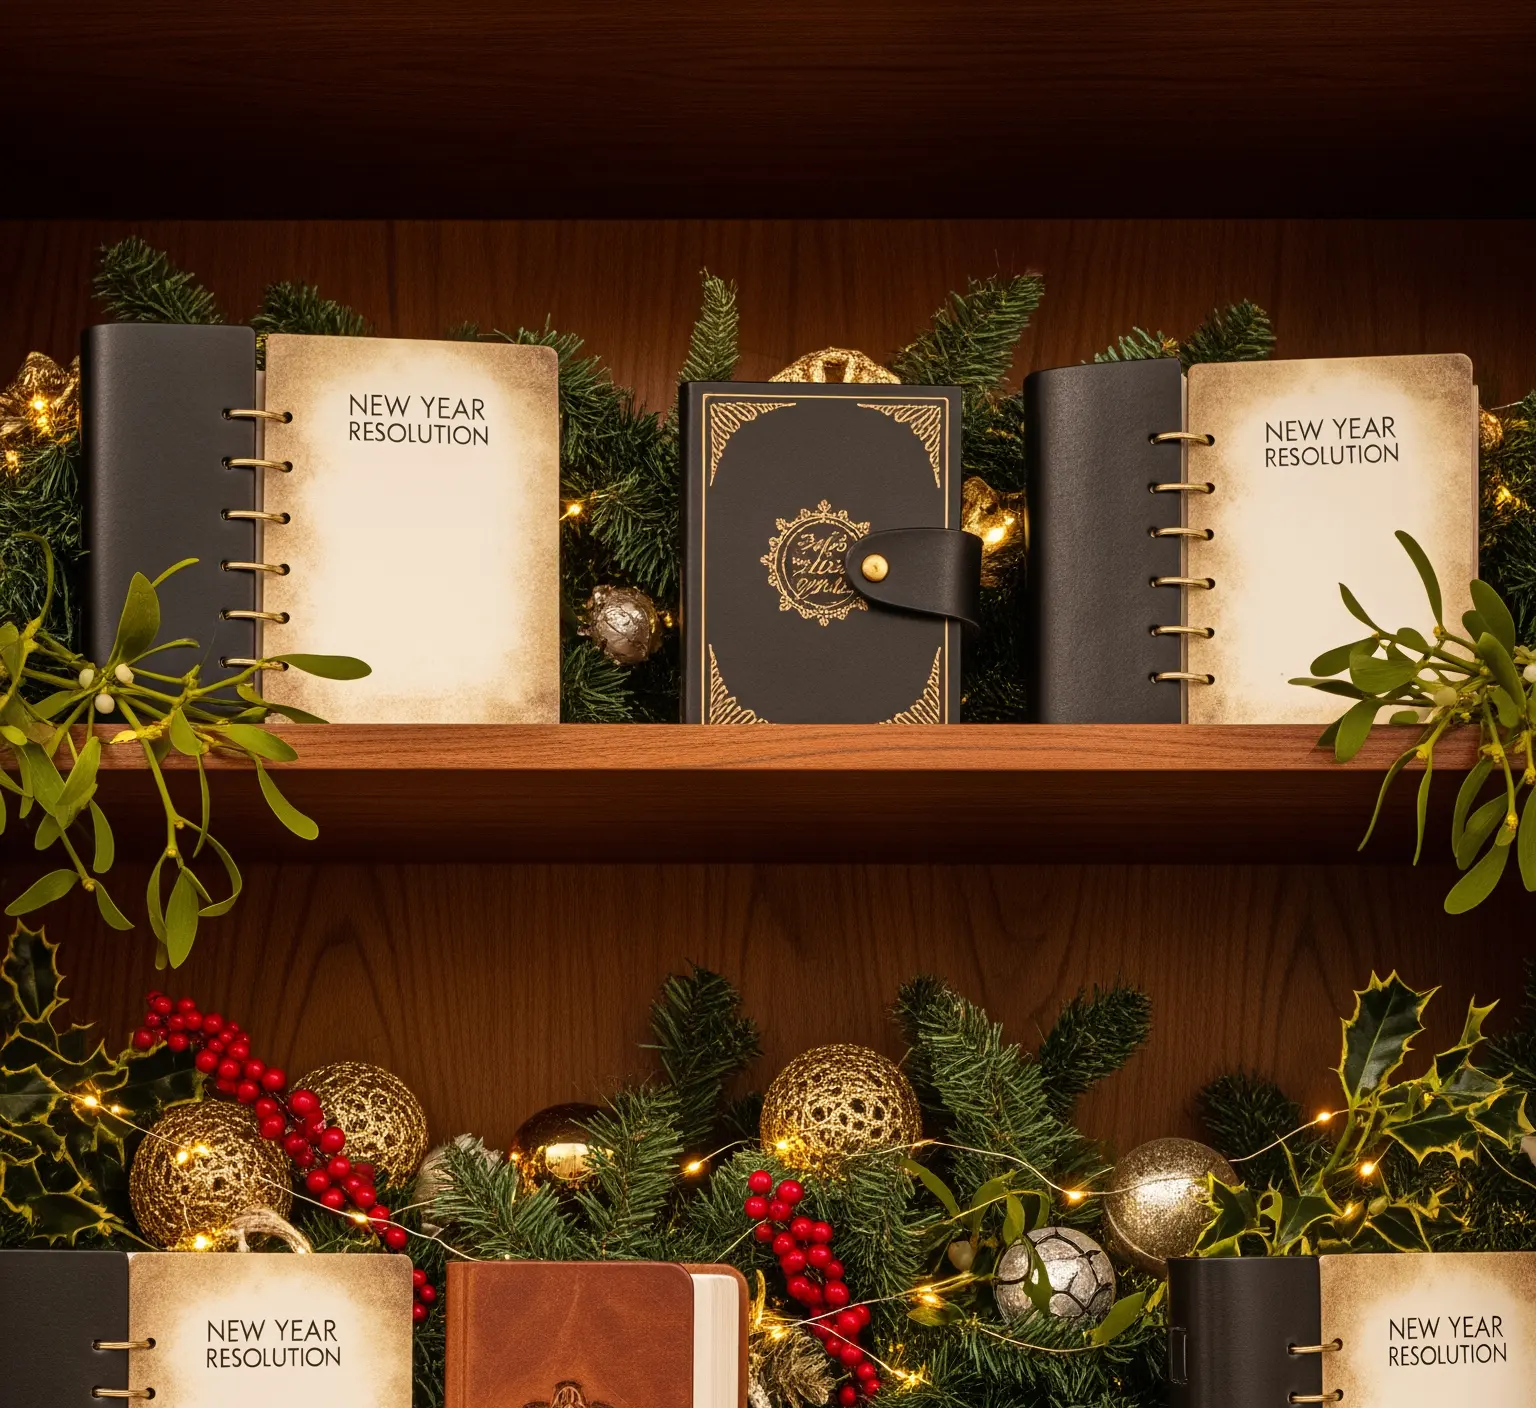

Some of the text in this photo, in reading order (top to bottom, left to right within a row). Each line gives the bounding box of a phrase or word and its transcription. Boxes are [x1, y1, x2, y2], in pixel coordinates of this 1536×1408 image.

[349, 393, 486, 421] NEW YEAR
[349, 421, 489, 446] RESOLUTION
[1265, 416, 1396, 443] NEW YEAR
[1265, 442, 1399, 468] RESOLUTION
[207, 1319, 338, 1343] NEW YEAR
[1389, 1315, 1504, 1341] NEW YEAR
[206, 1346, 341, 1368] RESOLUTION
[1389, 1342, 1507, 1367] RESOLUTION
